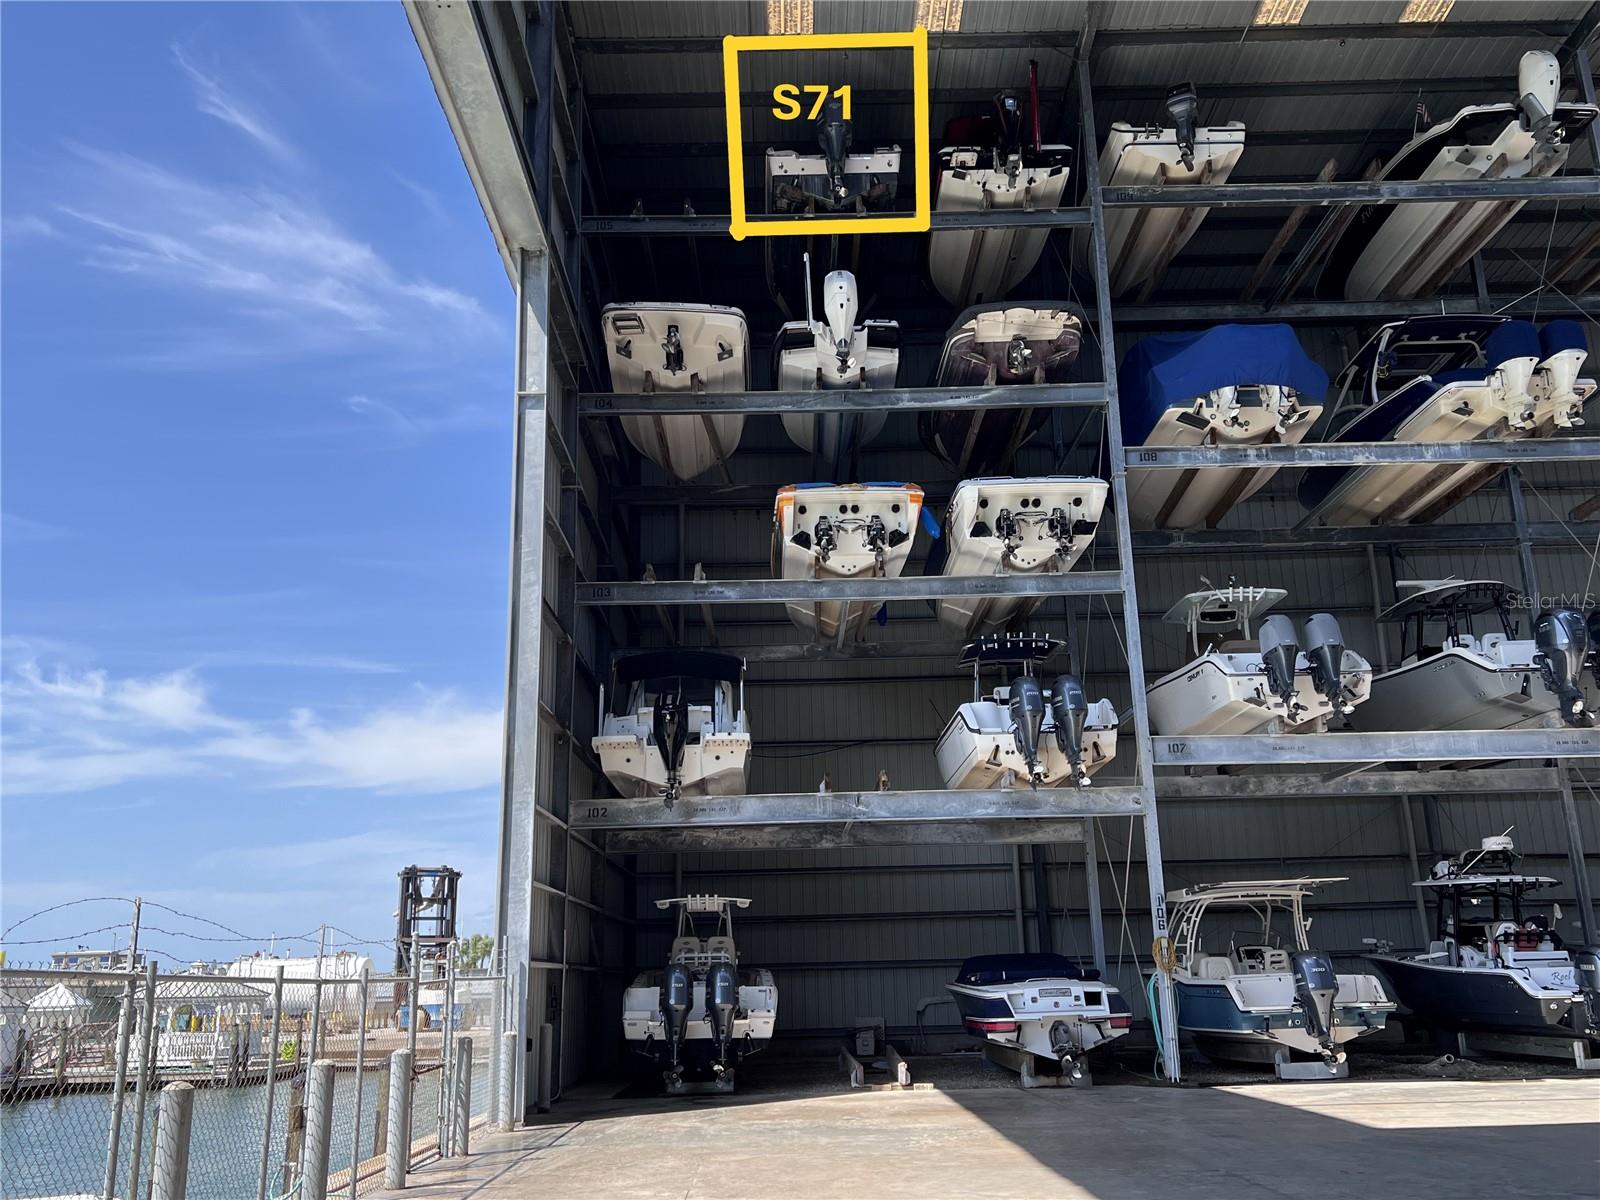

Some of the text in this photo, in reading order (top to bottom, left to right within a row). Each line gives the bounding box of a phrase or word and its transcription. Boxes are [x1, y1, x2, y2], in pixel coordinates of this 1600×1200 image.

[596, 221, 614, 231] 105
[594, 399, 613, 409] 104
[1139, 452, 1157, 462] 108
[592, 587, 611, 598] 103
[1167, 743, 1187, 753] 107
[587, 807, 608, 818] 102
[1156, 895, 1166, 930] 106
[1552, 970, 1572, 982] Reel
